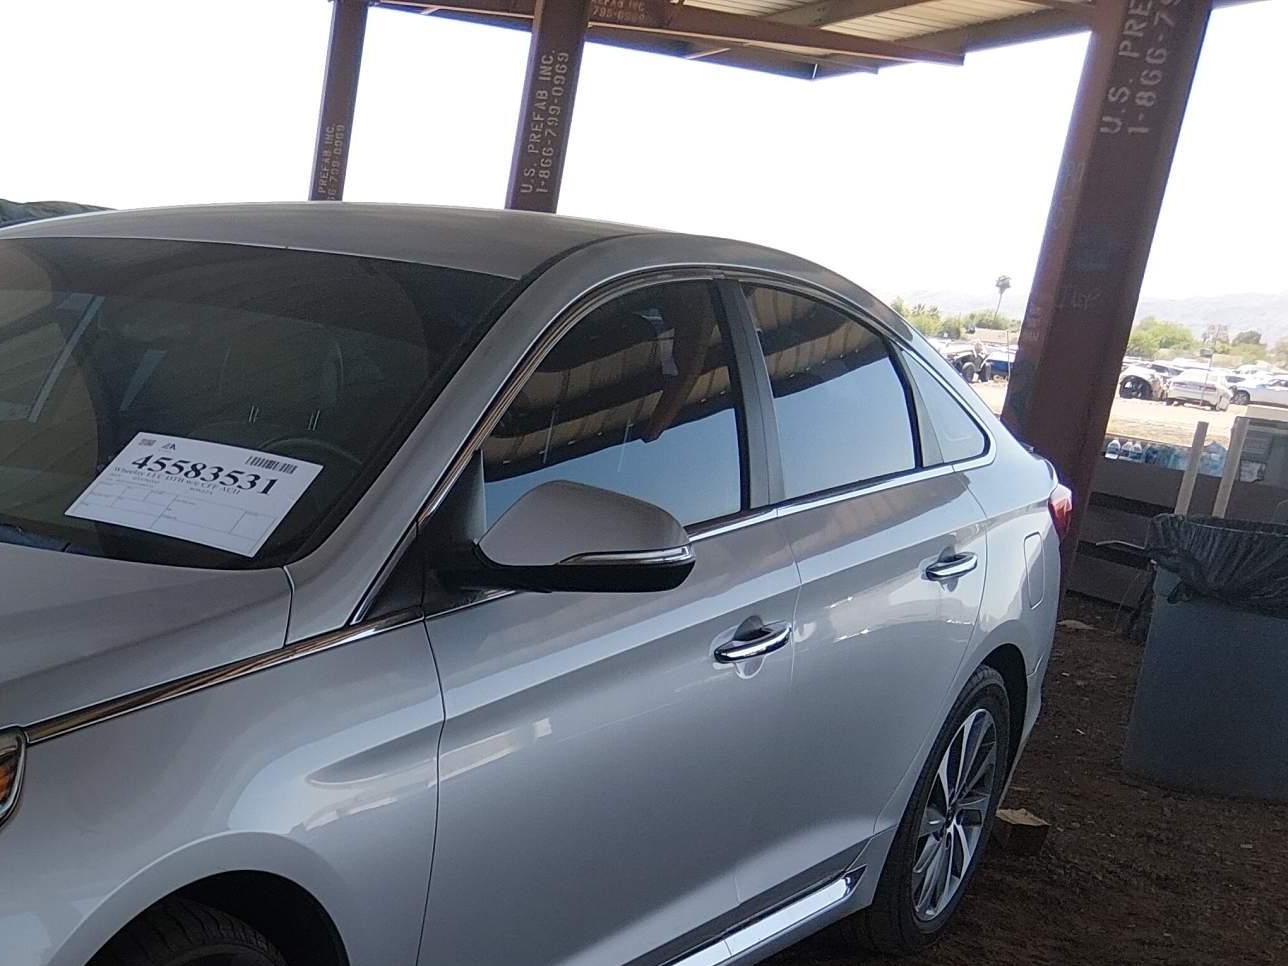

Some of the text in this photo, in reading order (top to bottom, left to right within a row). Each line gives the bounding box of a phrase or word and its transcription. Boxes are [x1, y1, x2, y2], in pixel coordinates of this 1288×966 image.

[519, 49, 556, 193] U.S. PREFAB INC.
[535, 52, 569, 193] 1-866-799-0969
[1099, 79, 1134, 135] U.S.
[317, 149, 332, 193] PREFAB
[132, 453, 280, 495] 45583531
